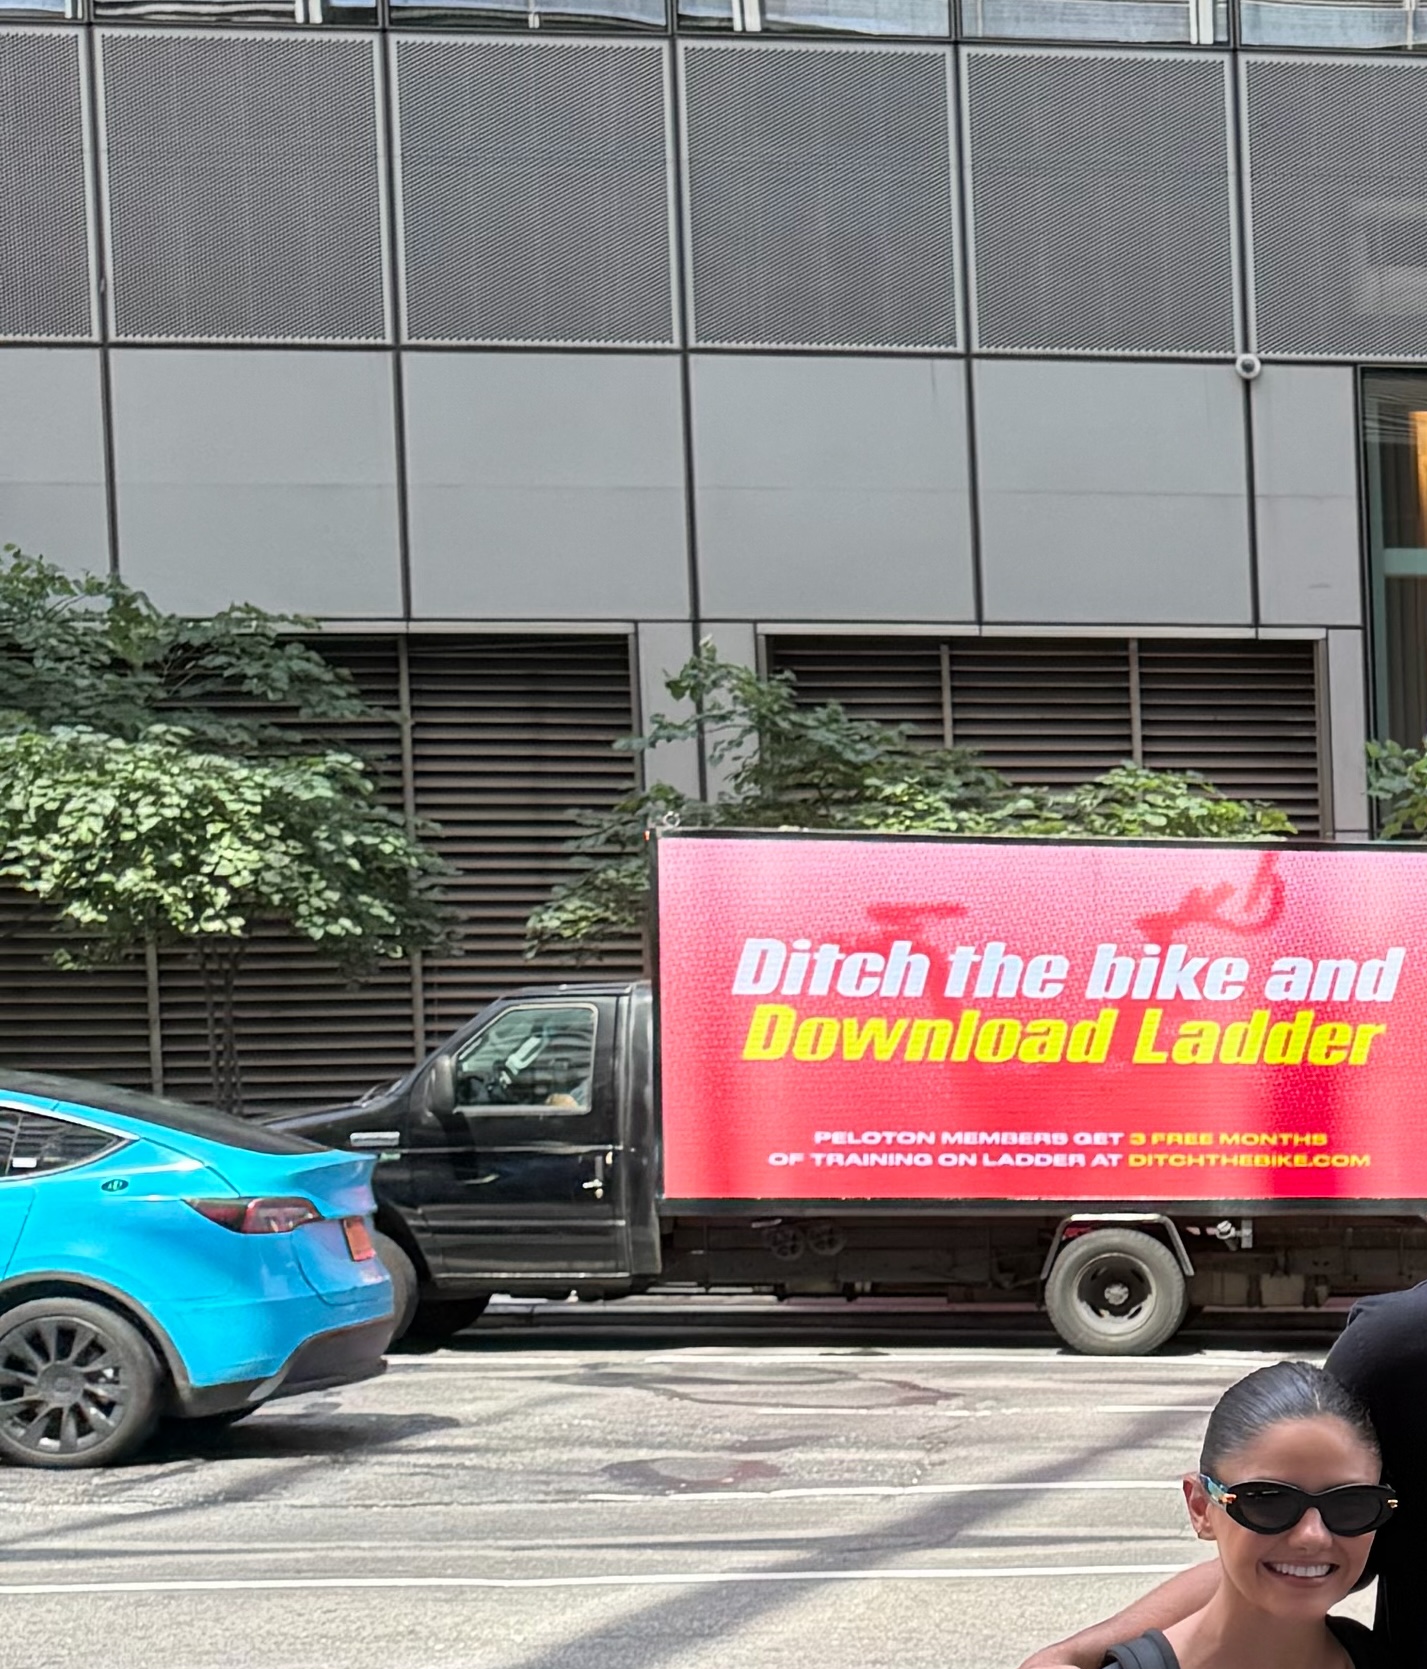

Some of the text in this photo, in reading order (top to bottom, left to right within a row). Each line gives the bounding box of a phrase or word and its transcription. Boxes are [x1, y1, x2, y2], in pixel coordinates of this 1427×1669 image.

[731, 938, 1406, 1002] Ditch the bike and
[741, 1003, 1387, 1065] Download Ladder
[813, 1130, 1328, 1146] PELOTON MEMBERS GET 3 FREE MONTHS
[768, 1152, 1371, 1168] OF TRAINING ON LADDER AT DITCHTHEBIKE.COM
